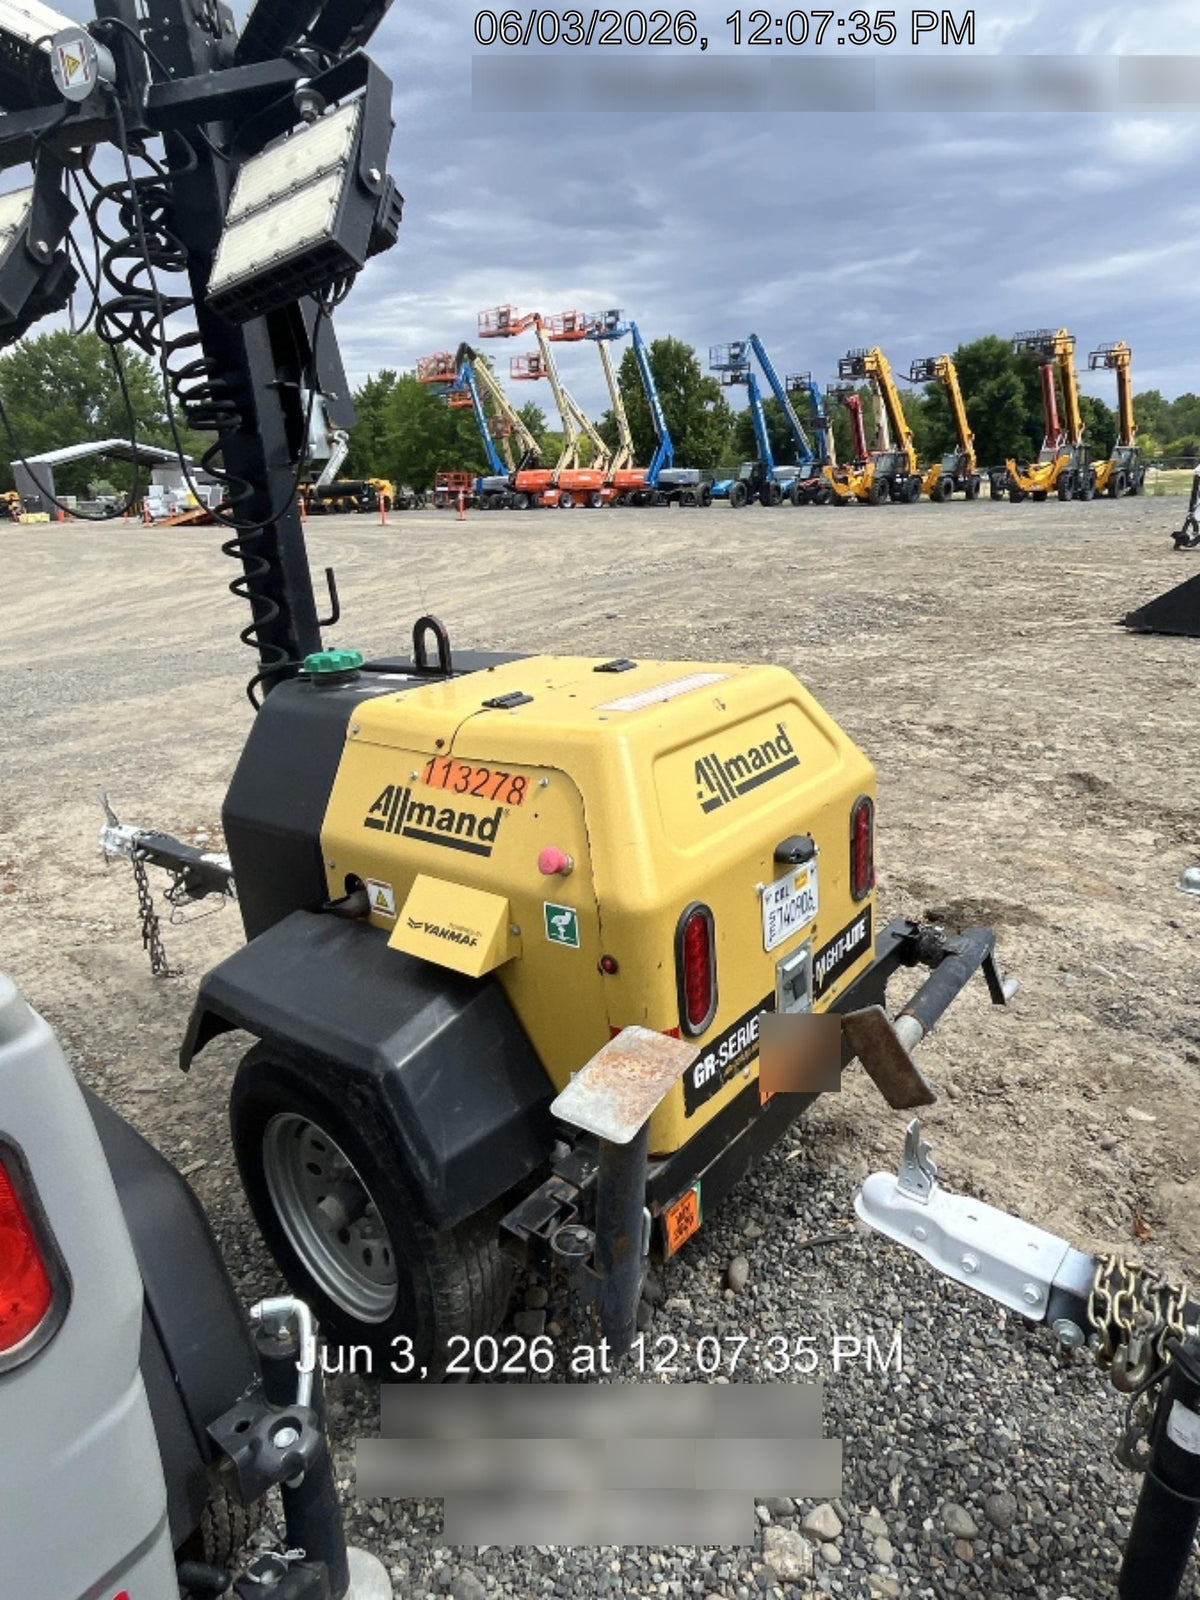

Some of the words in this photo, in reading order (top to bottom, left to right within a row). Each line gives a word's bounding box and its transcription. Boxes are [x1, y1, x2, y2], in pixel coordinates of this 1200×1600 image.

[425, 757, 527, 805] 113278
[693, 722, 796, 806] Allmand
[366, 784, 503, 846] Allmand
[423, 922, 479, 947] YANMAR
[693, 1010, 765, 1089] GR-SERIE
